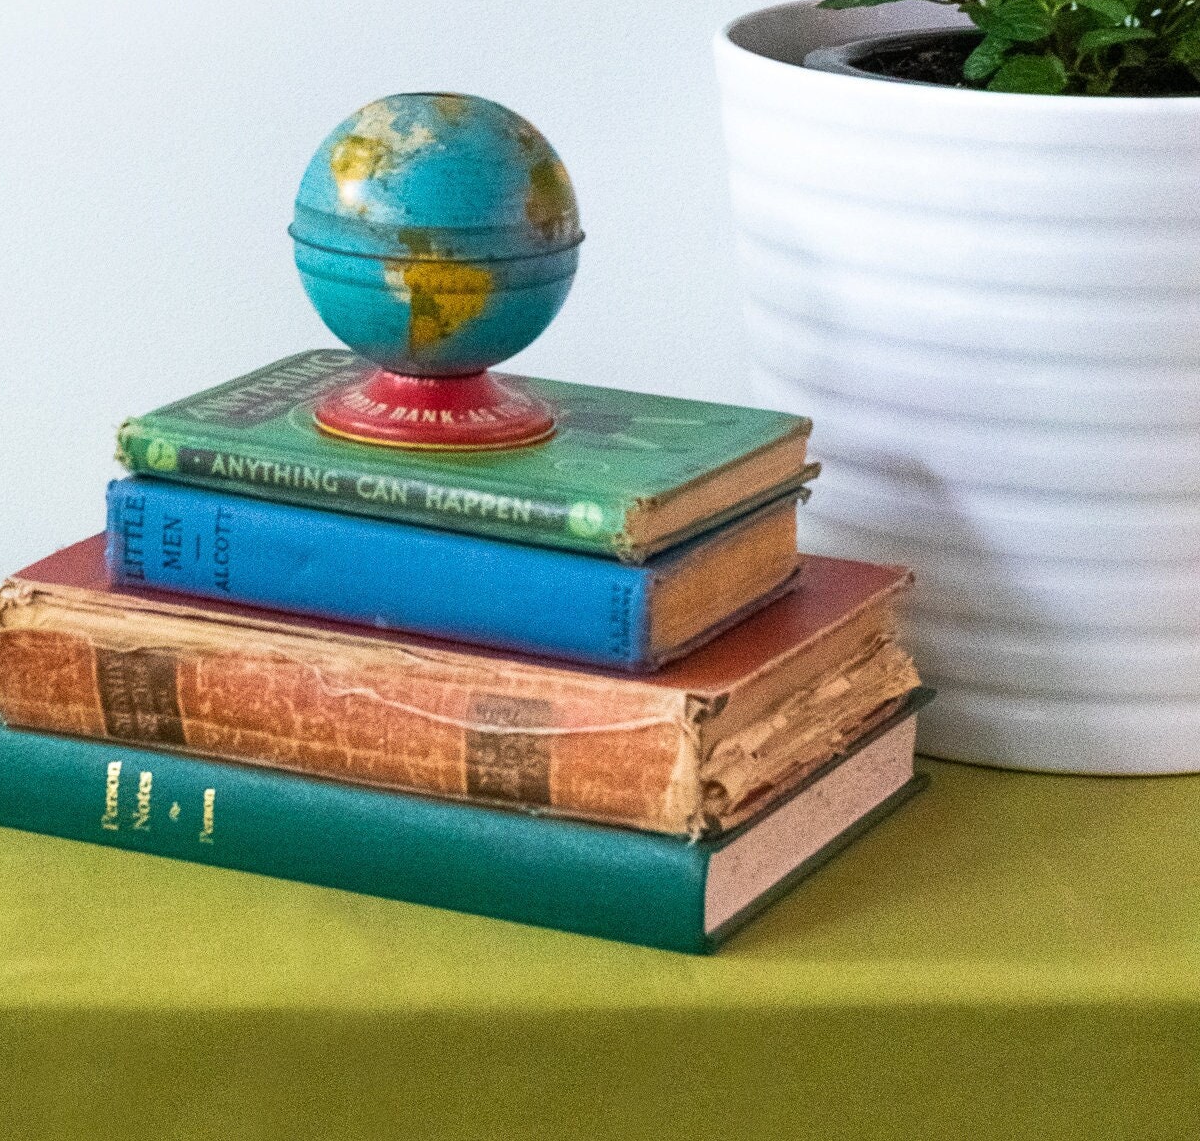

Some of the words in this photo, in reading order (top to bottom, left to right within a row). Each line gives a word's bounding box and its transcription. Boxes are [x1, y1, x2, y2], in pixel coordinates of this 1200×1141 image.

[211, 453, 338, 493] ANYTHING
[356, 475, 409, 505] CAN
[425, 484, 533, 523] HAPPEN
[124, 495, 145, 581] LITTLE
[162, 513, 183, 572] MEN
[214, 505, 232, 593] ALCOTT
[101, 760, 122, 831] Person
[133, 770, 153, 832] Notes
[199, 787, 216, 844] Person
